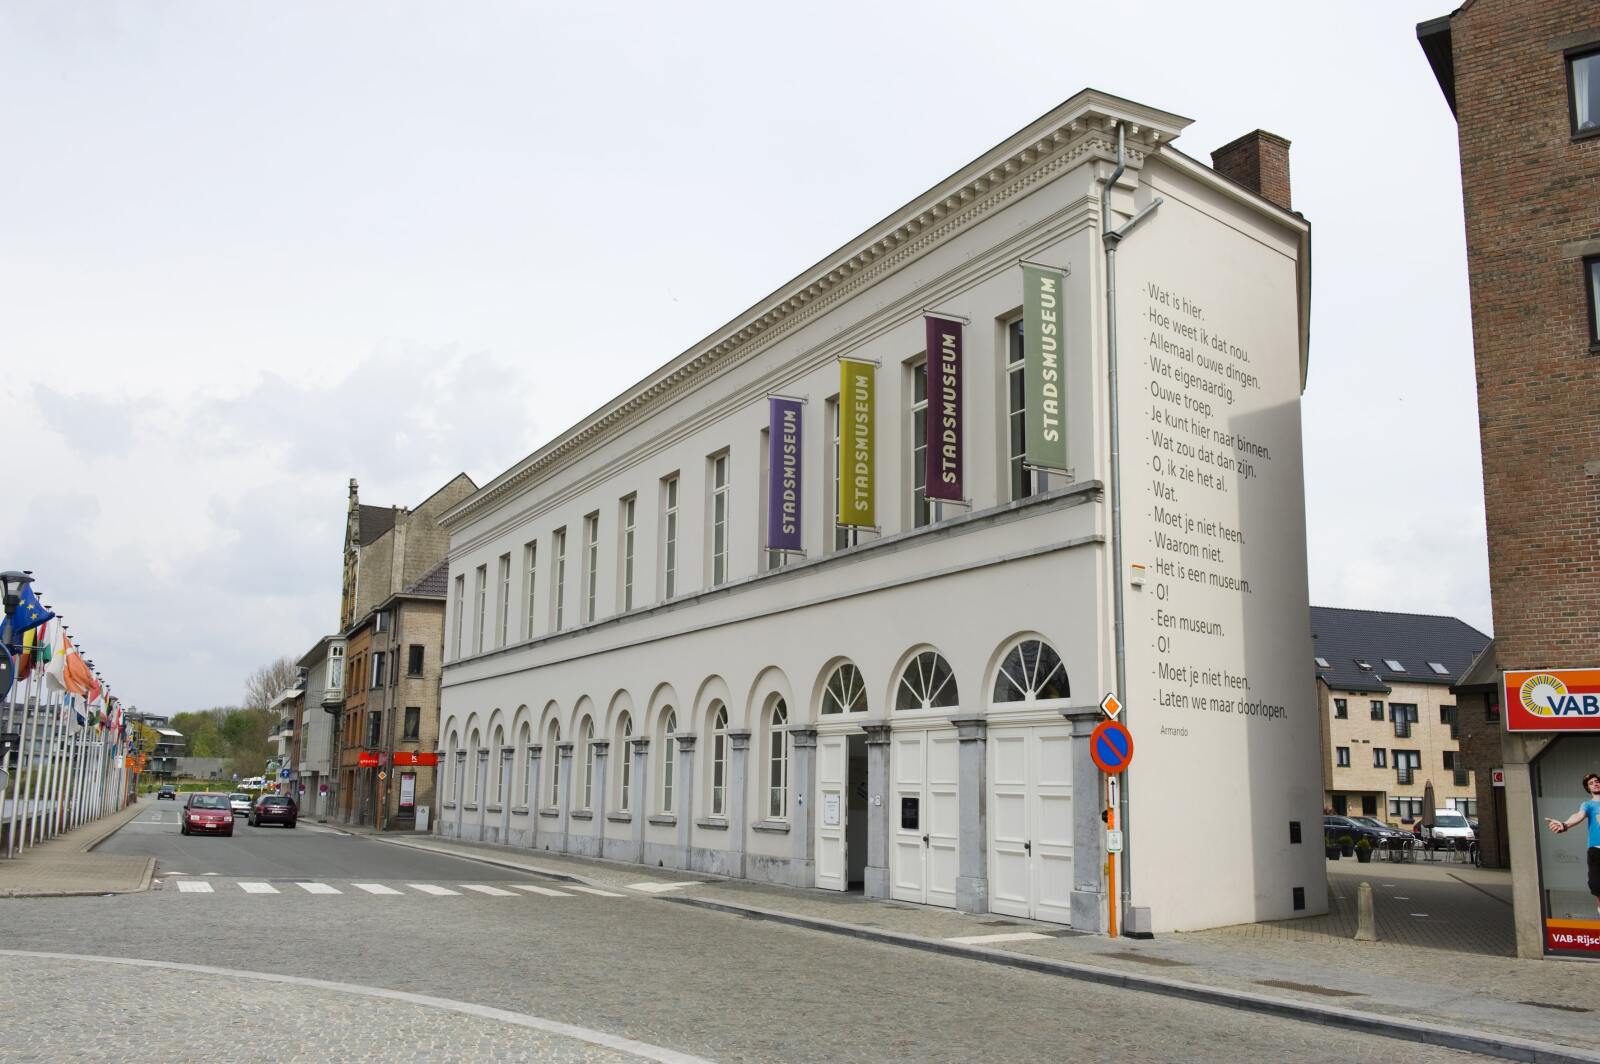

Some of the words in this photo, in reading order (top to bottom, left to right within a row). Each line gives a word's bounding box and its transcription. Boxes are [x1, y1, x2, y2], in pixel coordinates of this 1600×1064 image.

[1148, 282, 1170, 306] Wat
[1173, 293, 1180, 310] is
[1182, 297, 1205, 320] hier.
[1149, 306, 1170, 329] Hoe
[1172, 320, 1198, 341] weet
[1200, 328, 1209, 346] ik
[1212, 334, 1228, 354] dat
[1230, 345, 1250, 363] nou.
[1041, 276, 1059, 442] STADSMUSEUM
[1150, 332, 1194, 363] Allemaal
[1197, 354, 1223, 375] ouwe
[1226, 363, 1260, 390] dingen.
[1150, 355, 1171, 378] Wat
[1174, 367, 1236, 405] eigenaardig.
[942, 333, 956, 483] STADSMUSEUM
[1151, 381, 1181, 406] Ouwe
[1184, 394, 1214, 419] troep.
[855, 375, 869, 511] STADSMUSEUM
[1152, 405, 1162, 423] Je
[1165, 408, 1189, 432] kunt
[1192, 418, 1210, 440] hier
[1214, 430, 1234, 448] naar
[1237, 433, 1272, 461] binnen.
[782, 409, 797, 534] STADSMUSEUM
[1152, 429, 1174, 452] Wat
[1177, 441, 1195, 459] zou
[1198, 445, 1214, 465] dat
[1217, 451, 1235, 471] dan
[1237, 458, 1257, 479] zijn.
[1152, 455, 1164, 476] O,
[1168, 459, 1177, 477] ik
[1180, 464, 1194, 482] zie
[1197, 468, 1214, 488] het
[1216, 475, 1228, 493] al.
[1153, 480, 1178, 502] Wat.
[1154, 505, 1182, 528] Moet
[1185, 513, 1194, 534] je
[1197, 518, 1216, 537] niet
[1219, 522, 1245, 544] heen.
[1154, 531, 1199, 557] Waarom
[1202, 544, 1224, 563] niet.
[1156, 557, 1175, 577] Het
[1178, 561, 1185, 579] is
[1188, 567, 1206, 583] een
[1209, 573, 1252, 594] museum.
[1156, 583, 1169, 601] O!
[1157, 609, 1176, 629] Een
[1180, 617, 1225, 637] museum.
[1158, 636, 1170, 653] O!
[1158, 662, 1187, 682] Moet
[1189, 665, 1198, 687] je
[1202, 668, 1221, 687] niet
[1224, 670, 1251, 690] heen.
[1159, 688, 1188, 709] Laten
[1191, 696, 1207, 711] we
[1210, 697, 1235, 713] maar
[1237, 697, 1288, 721] doorlopen.
[1546, 695, 1600, 715] VAB
[1160, 725, 1188, 736] Armando
[1552, 934, 1600, 946] VAB-Rijsc
